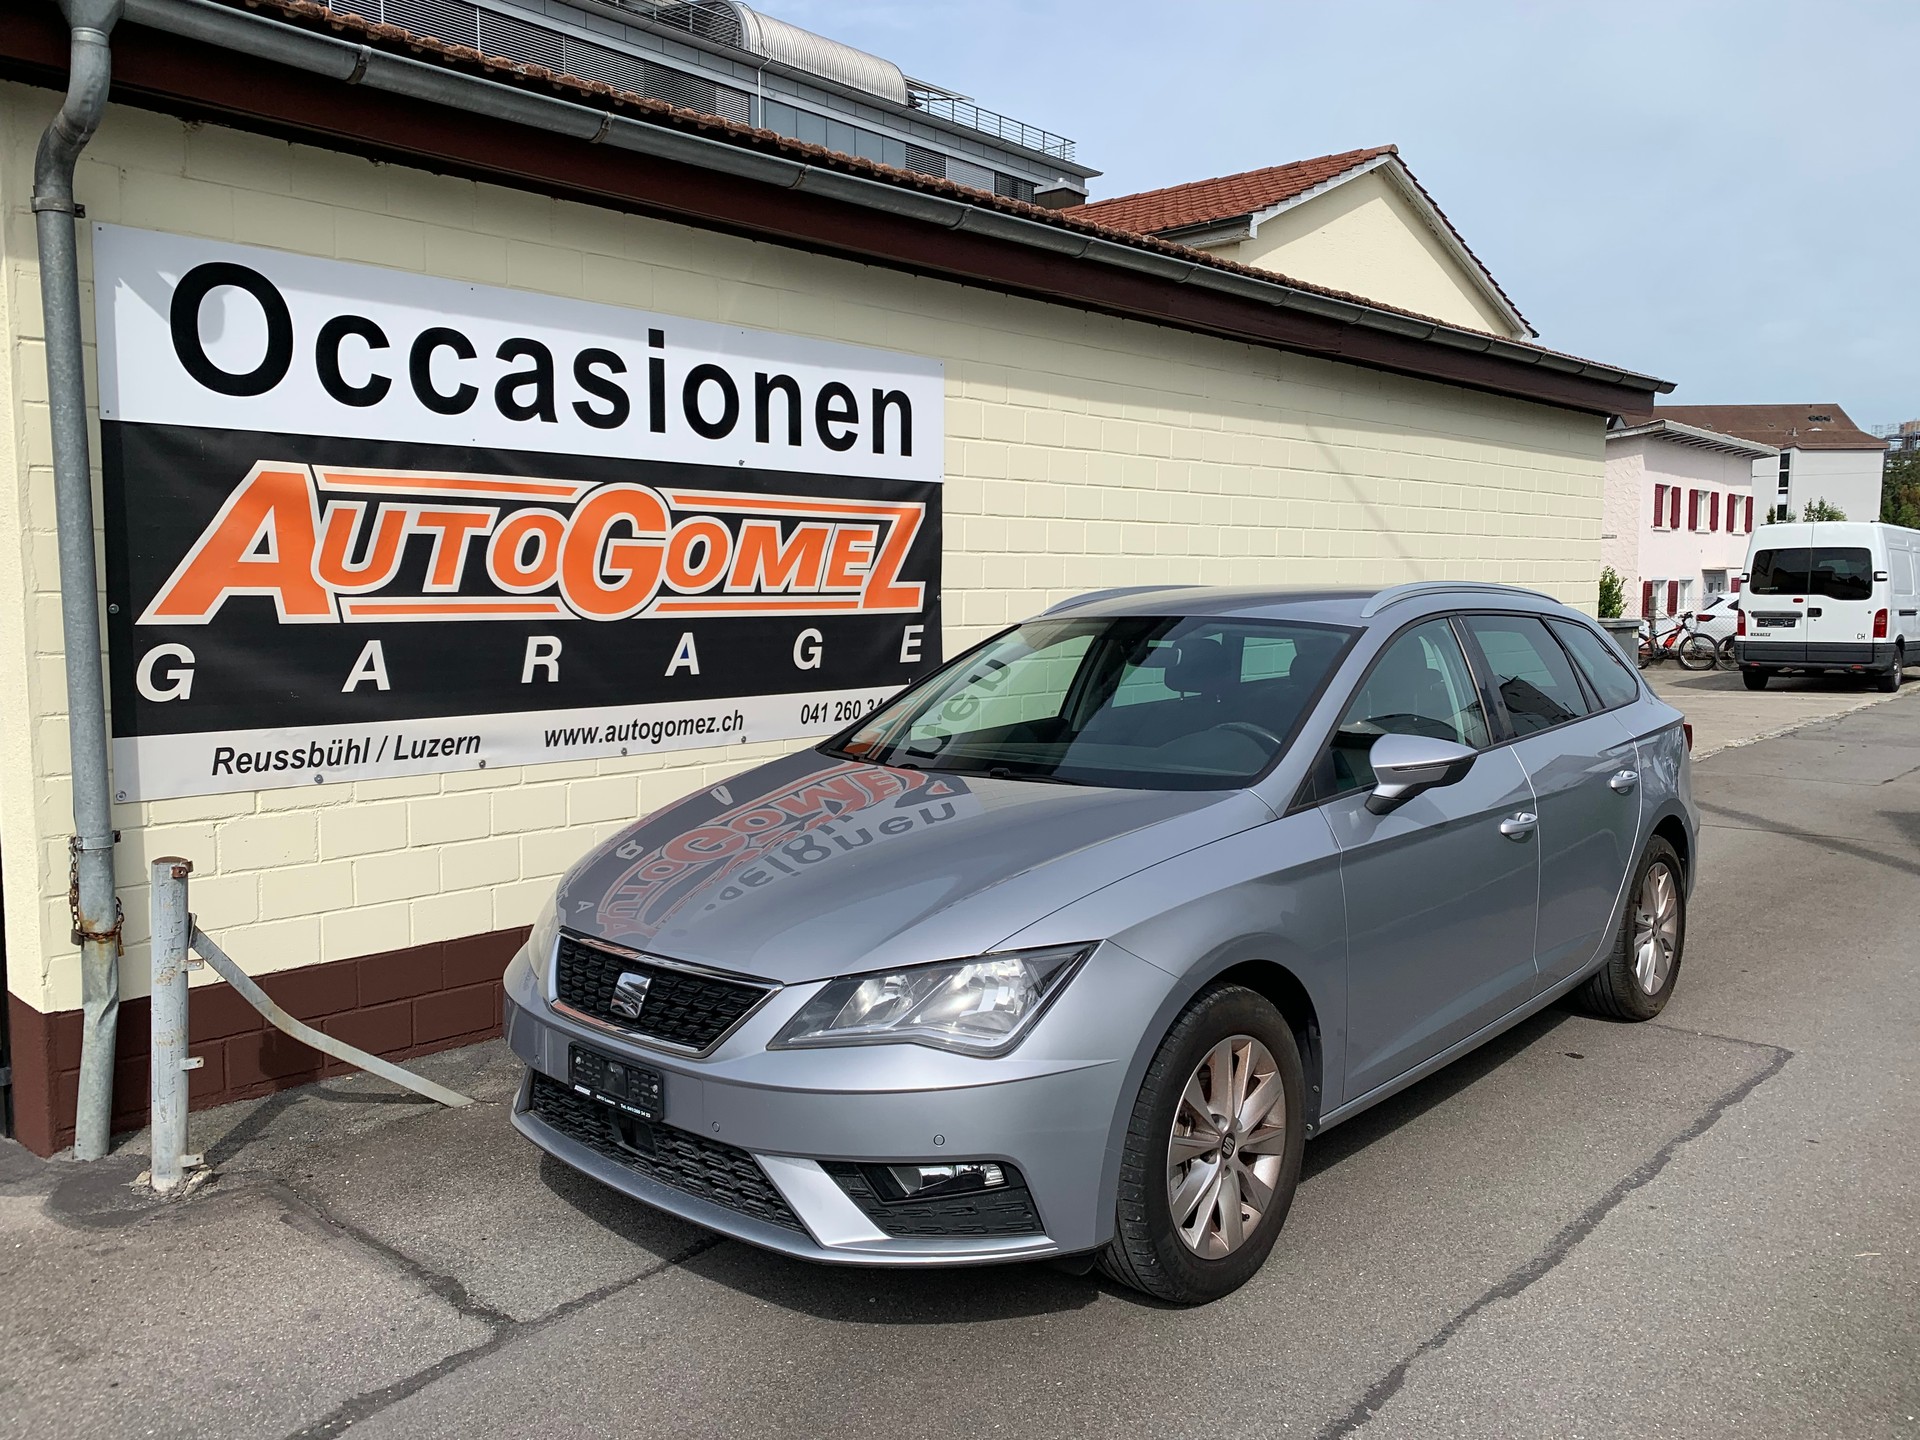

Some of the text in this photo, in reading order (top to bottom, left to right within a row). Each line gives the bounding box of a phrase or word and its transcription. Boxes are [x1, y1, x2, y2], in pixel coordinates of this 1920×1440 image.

[170, 261, 914, 458] Occasionen
[135, 623, 923, 703] GARAGE
[543, 710, 744, 748] www.autogomez.ch
[801, 702, 828, 725] 041
[834, 700, 862, 722] 260
[211, 737, 371, 776] Reussbühl
[394, 733, 481, 762] Luzern
